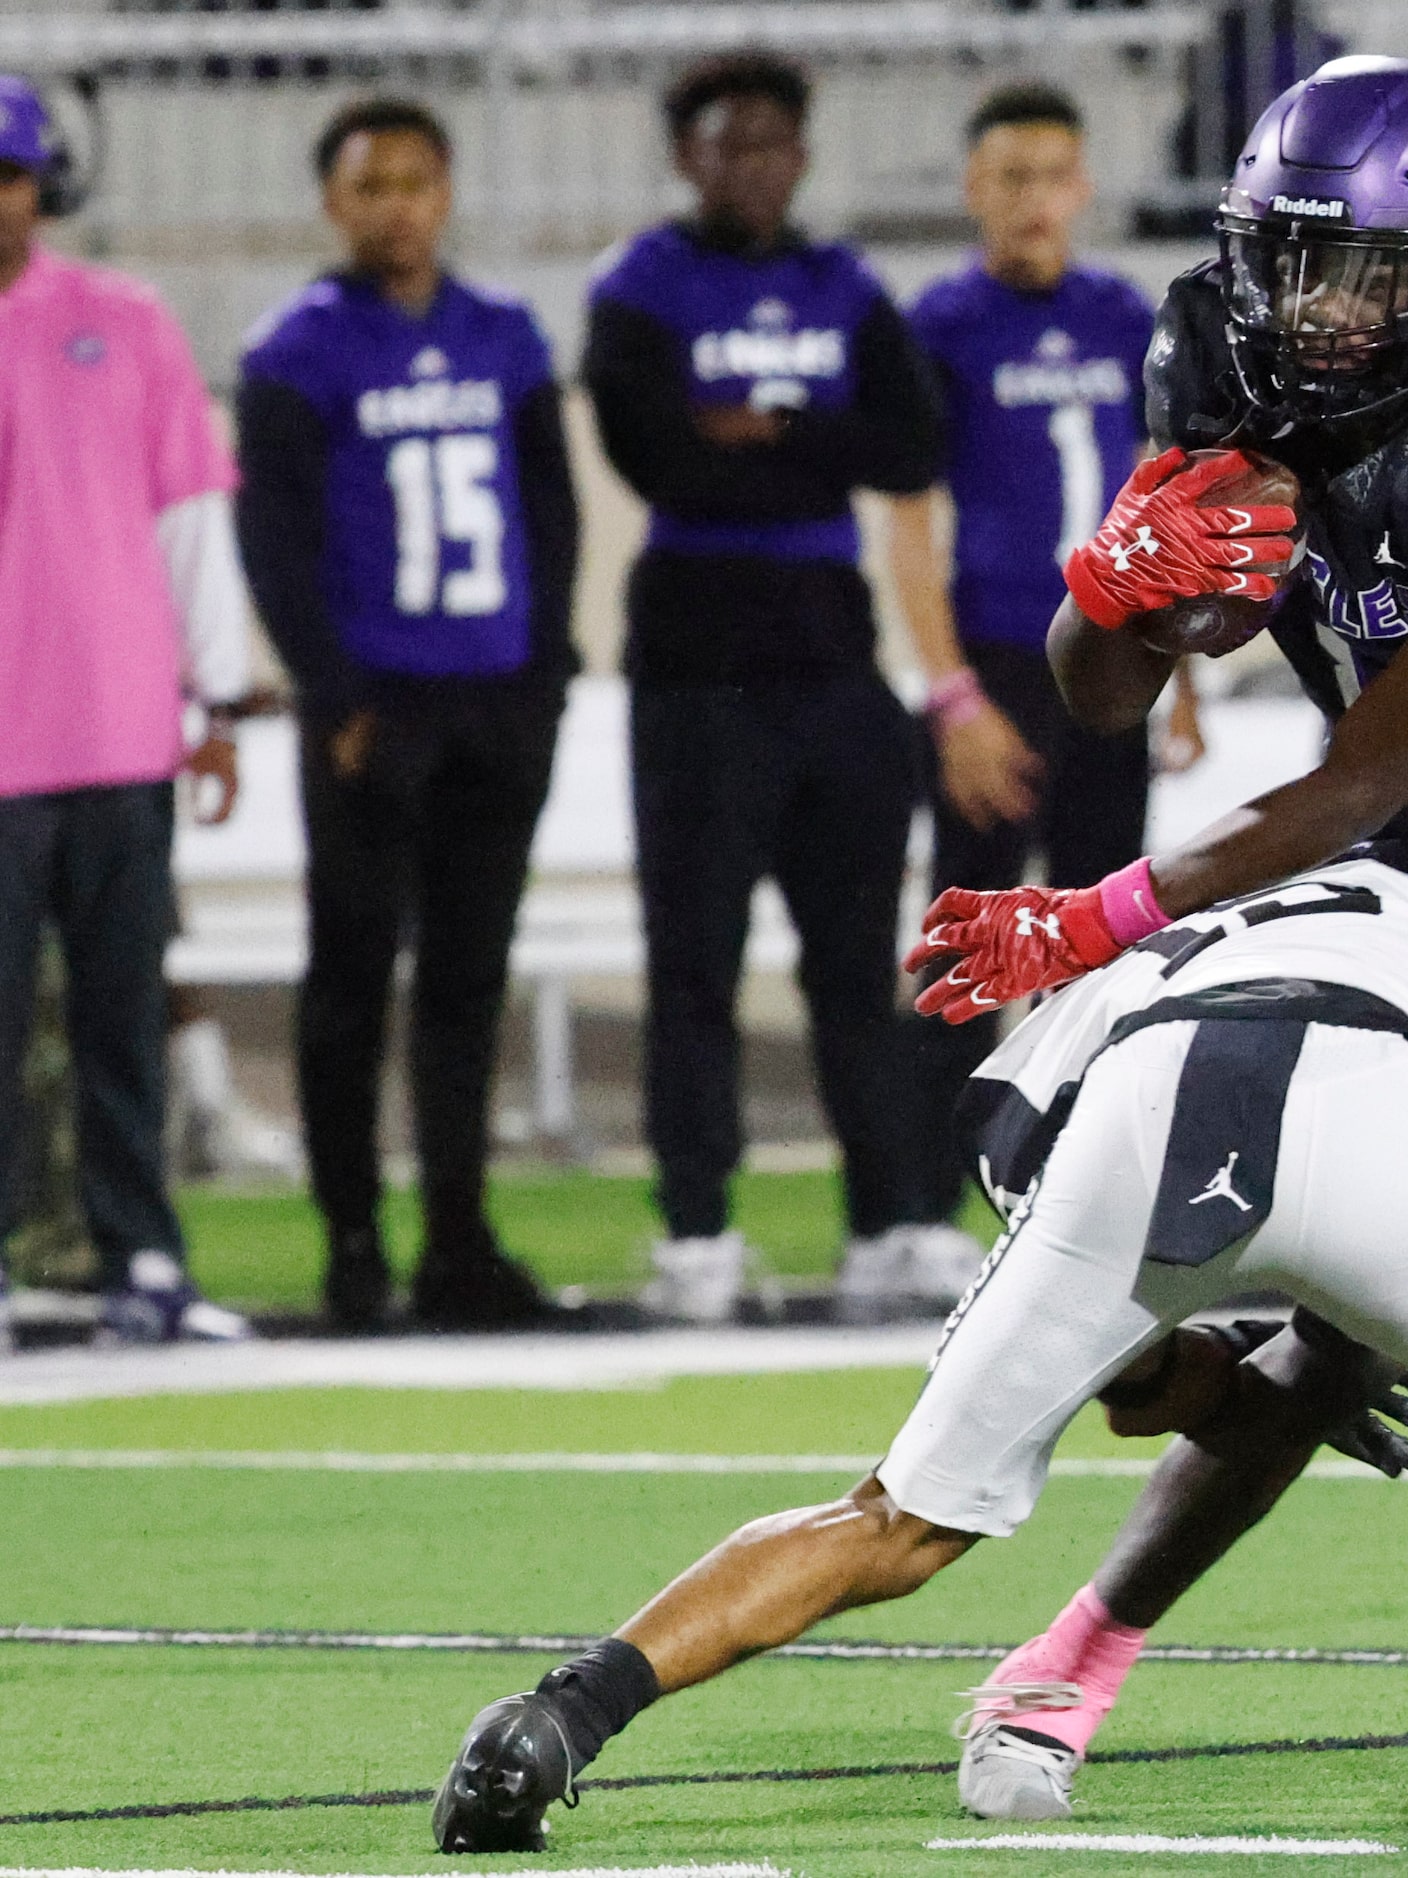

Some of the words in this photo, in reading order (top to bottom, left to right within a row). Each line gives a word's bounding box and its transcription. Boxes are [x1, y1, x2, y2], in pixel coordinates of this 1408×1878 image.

[1273, 194, 1344, 218] Riddell
[386, 434, 505, 616] 15
[1048, 402, 1104, 568] 1
